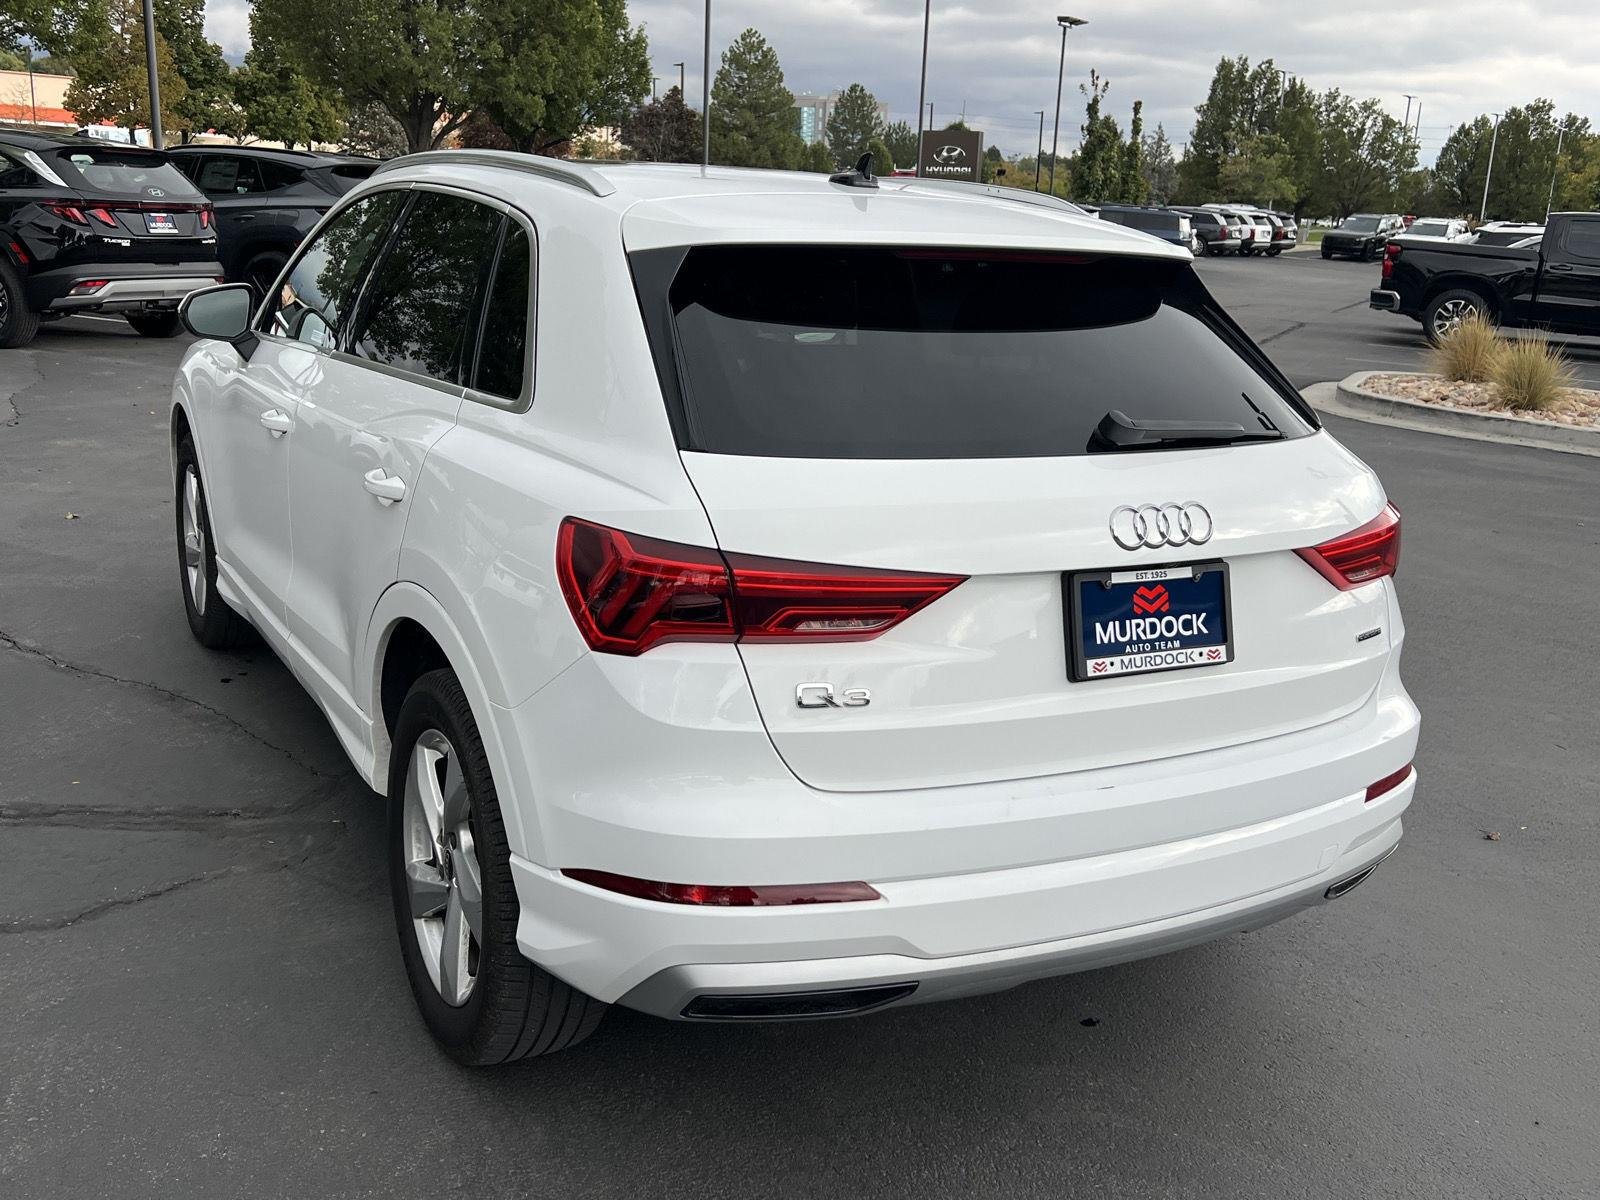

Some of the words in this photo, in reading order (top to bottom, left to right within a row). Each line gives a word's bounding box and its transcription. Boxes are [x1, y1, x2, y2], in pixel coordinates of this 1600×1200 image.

[1095, 613, 1208, 644] MURDOCK
[1125, 643, 1151, 653] AUTO
[1154, 640, 1181, 650] TEAM
[1120, 651, 1195, 670] MURDOCK
[796, 682, 870, 708] Q3
